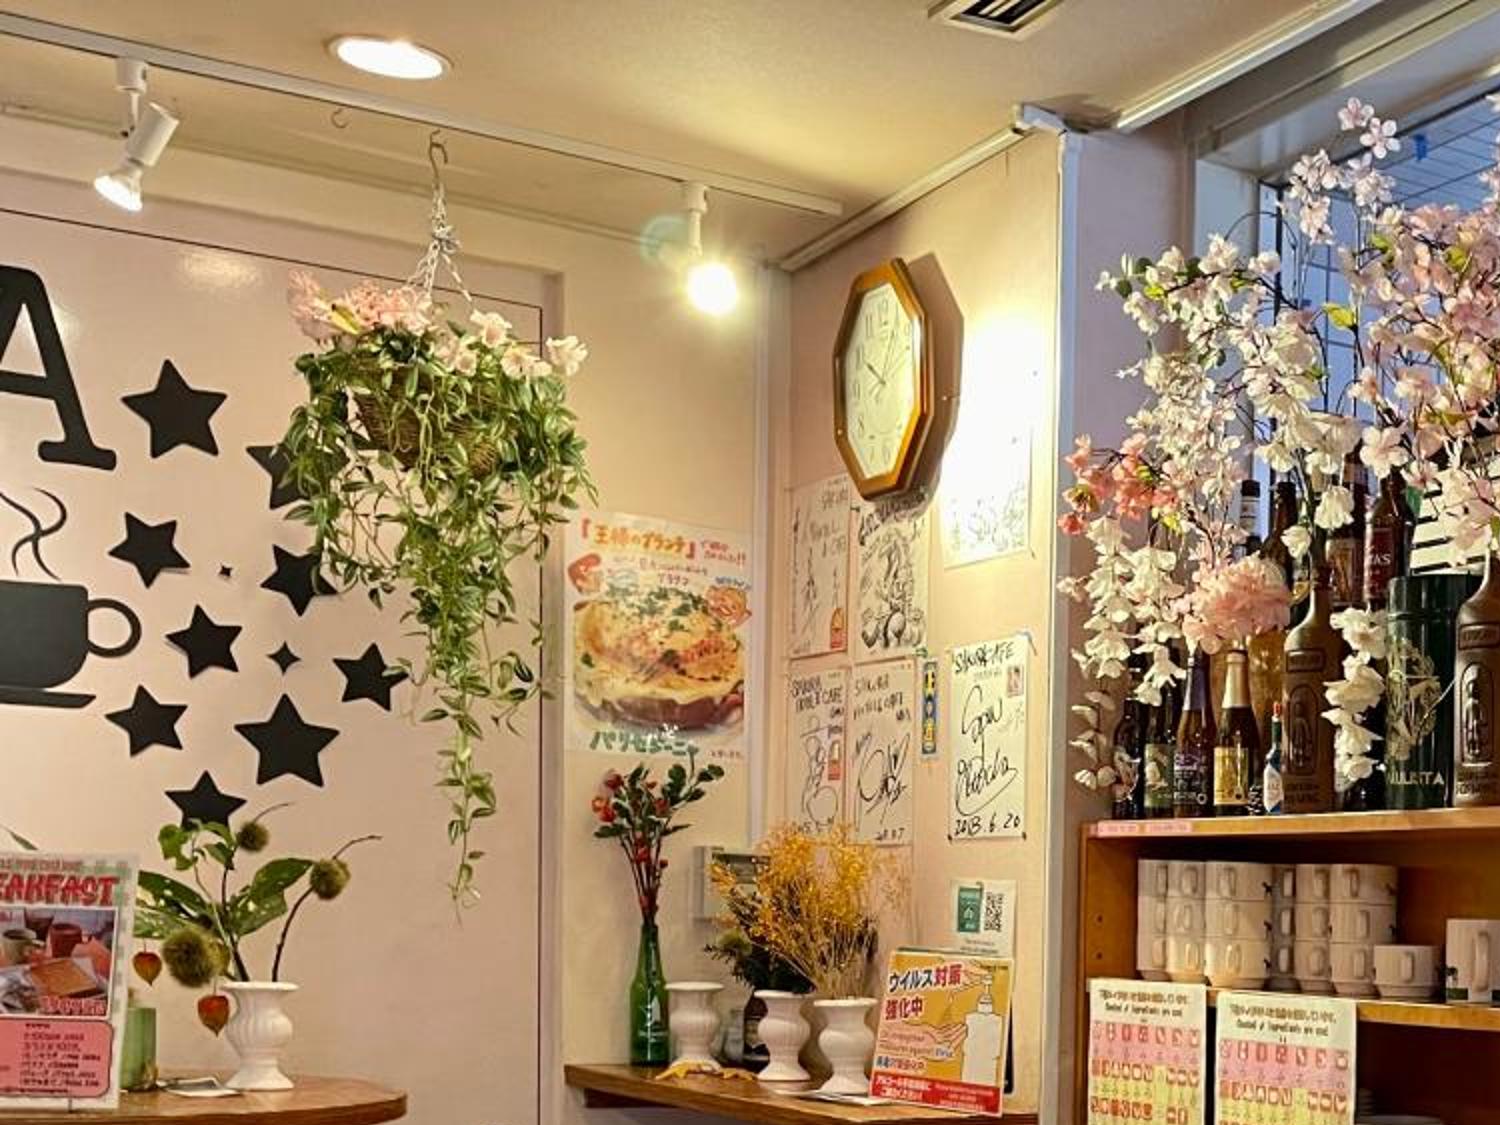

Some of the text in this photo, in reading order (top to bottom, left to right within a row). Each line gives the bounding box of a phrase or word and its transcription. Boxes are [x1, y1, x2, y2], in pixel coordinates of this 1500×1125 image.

[889, 963, 963, 993] ウイルス対策
[885, 996, 923, 1021] 強化中
